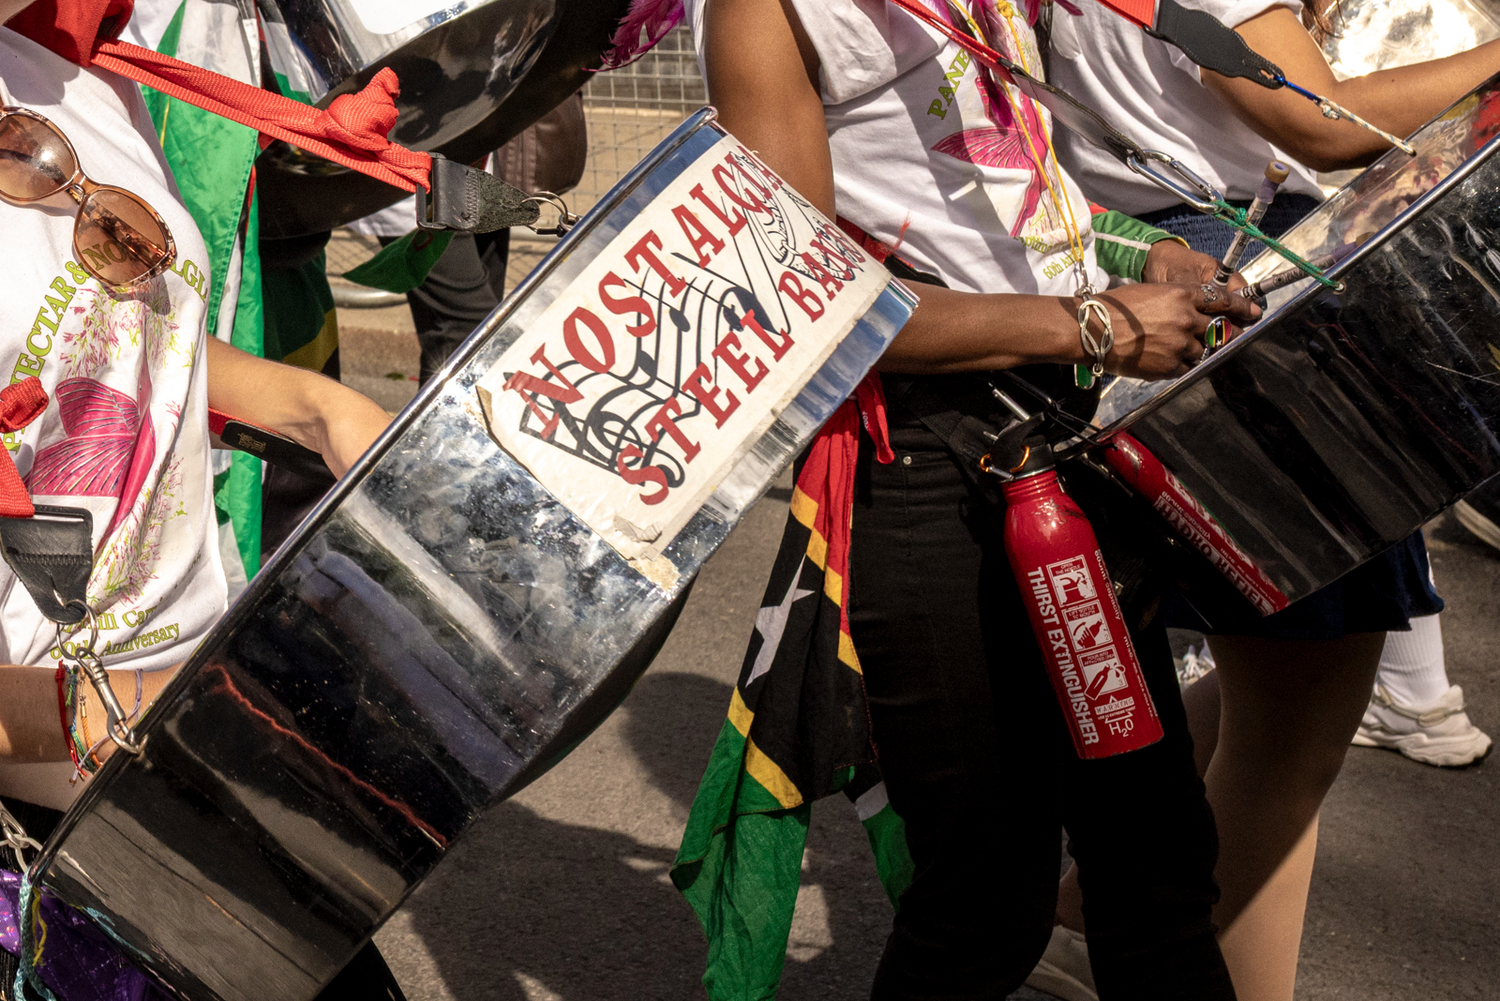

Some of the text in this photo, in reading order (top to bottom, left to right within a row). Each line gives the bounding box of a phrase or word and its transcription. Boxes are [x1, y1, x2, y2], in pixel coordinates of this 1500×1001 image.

[65, 260, 92, 285] &
[1043, 260, 1065, 280] 60th
[502, 143, 786, 440] NOSTALGIA
[617, 222, 868, 505] STEEL BAND
[1105, 582, 1121, 620] capacity
[100, 623, 180, 657] Anniversary
[1027, 566, 1100, 746] THIRST EXTINGUISHER
[1096, 697, 1134, 713] WARNING
